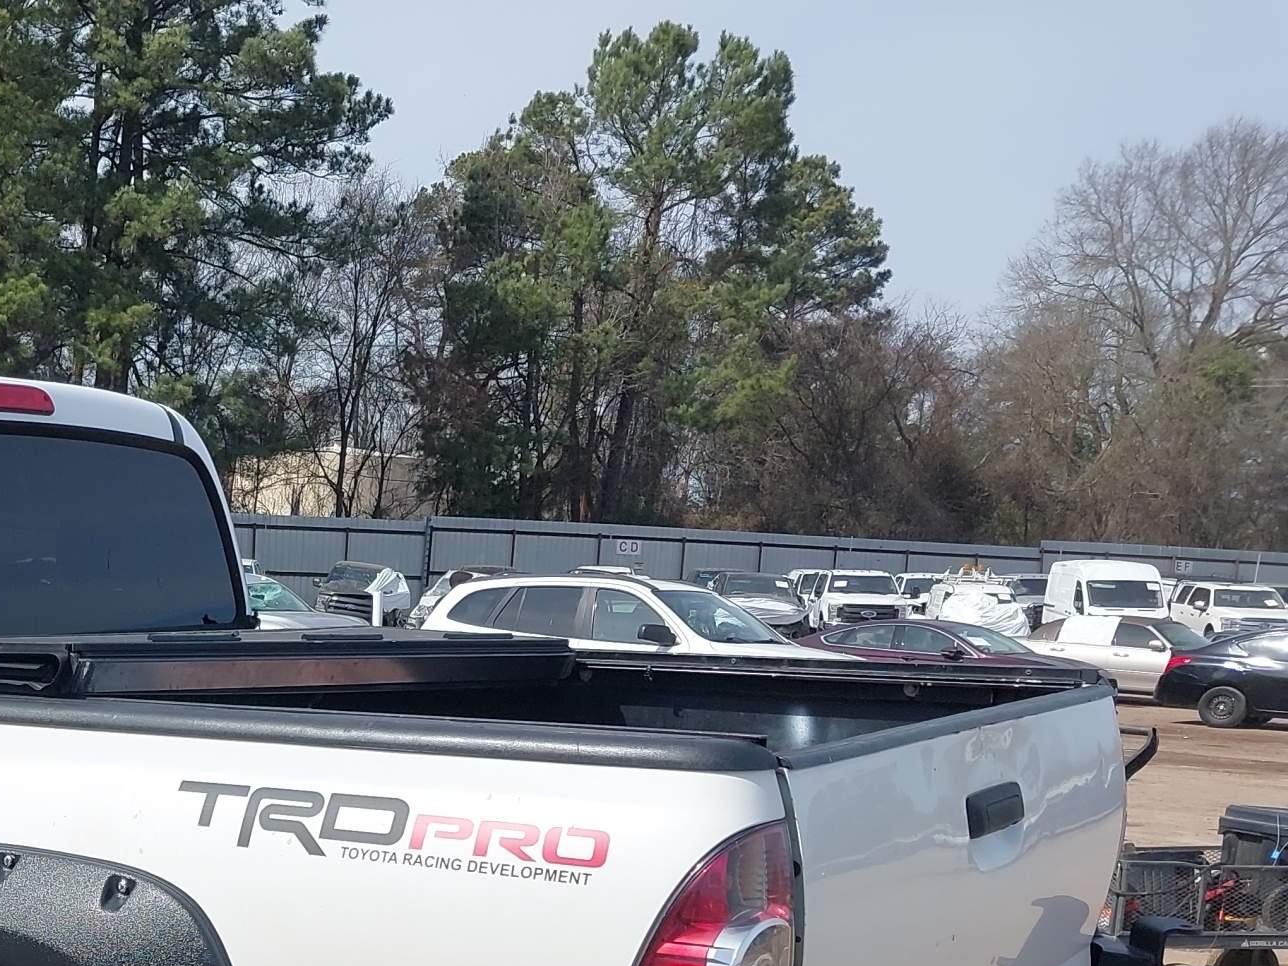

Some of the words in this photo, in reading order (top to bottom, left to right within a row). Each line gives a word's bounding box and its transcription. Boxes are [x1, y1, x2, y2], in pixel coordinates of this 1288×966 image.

[178, 780, 410, 857] TRD
[408, 814, 611, 868] PRO
[341, 847, 398, 865] TOYOTA
[402, 853, 462, 871] RACING
[467, 860, 592, 886] DEVELOPMENT
